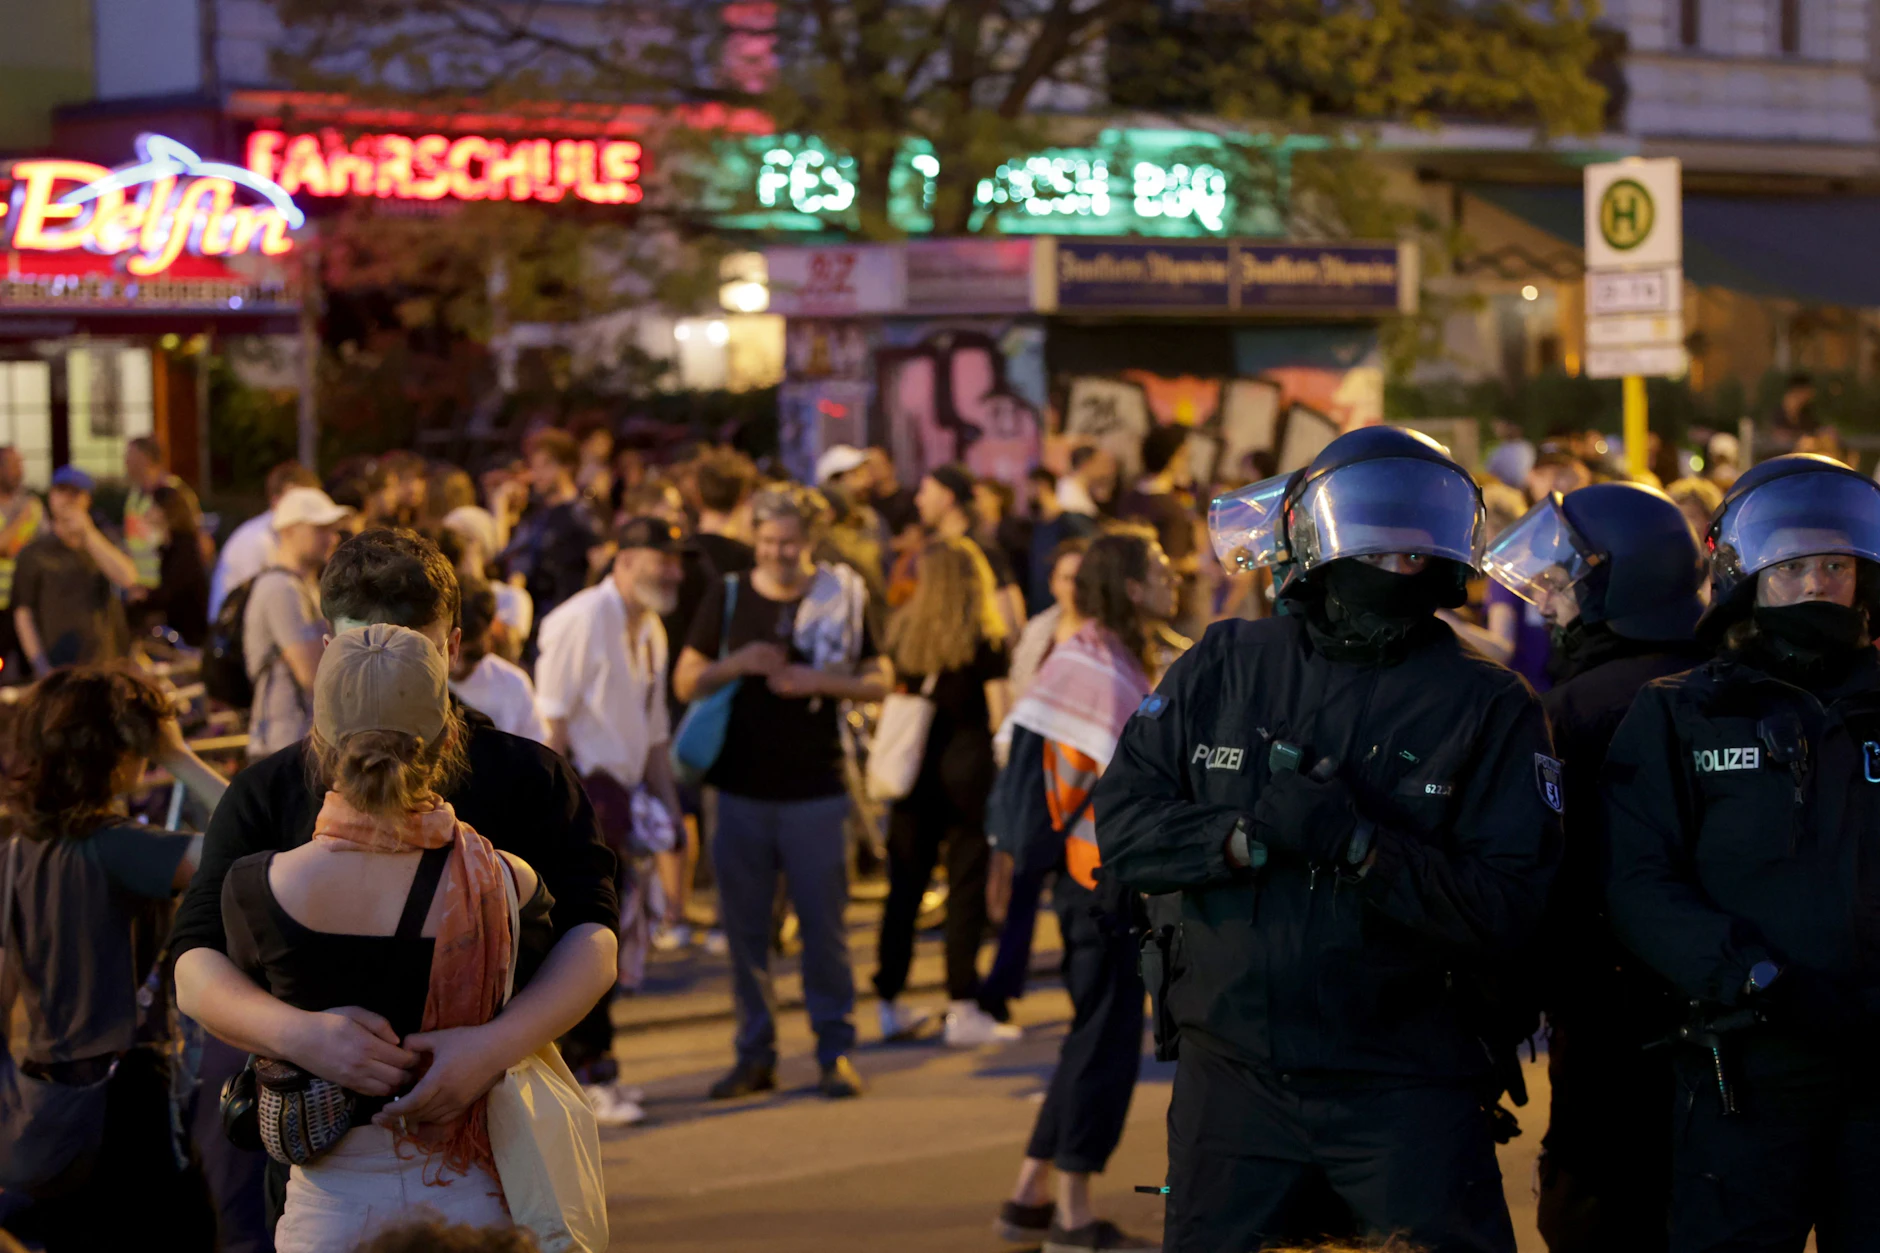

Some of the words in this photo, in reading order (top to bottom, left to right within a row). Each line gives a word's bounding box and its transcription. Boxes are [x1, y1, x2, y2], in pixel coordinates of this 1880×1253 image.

[12, 160, 294, 275] Delfin
[1612, 197, 1637, 233] H
[1693, 747, 1759, 772] POLIZEI
